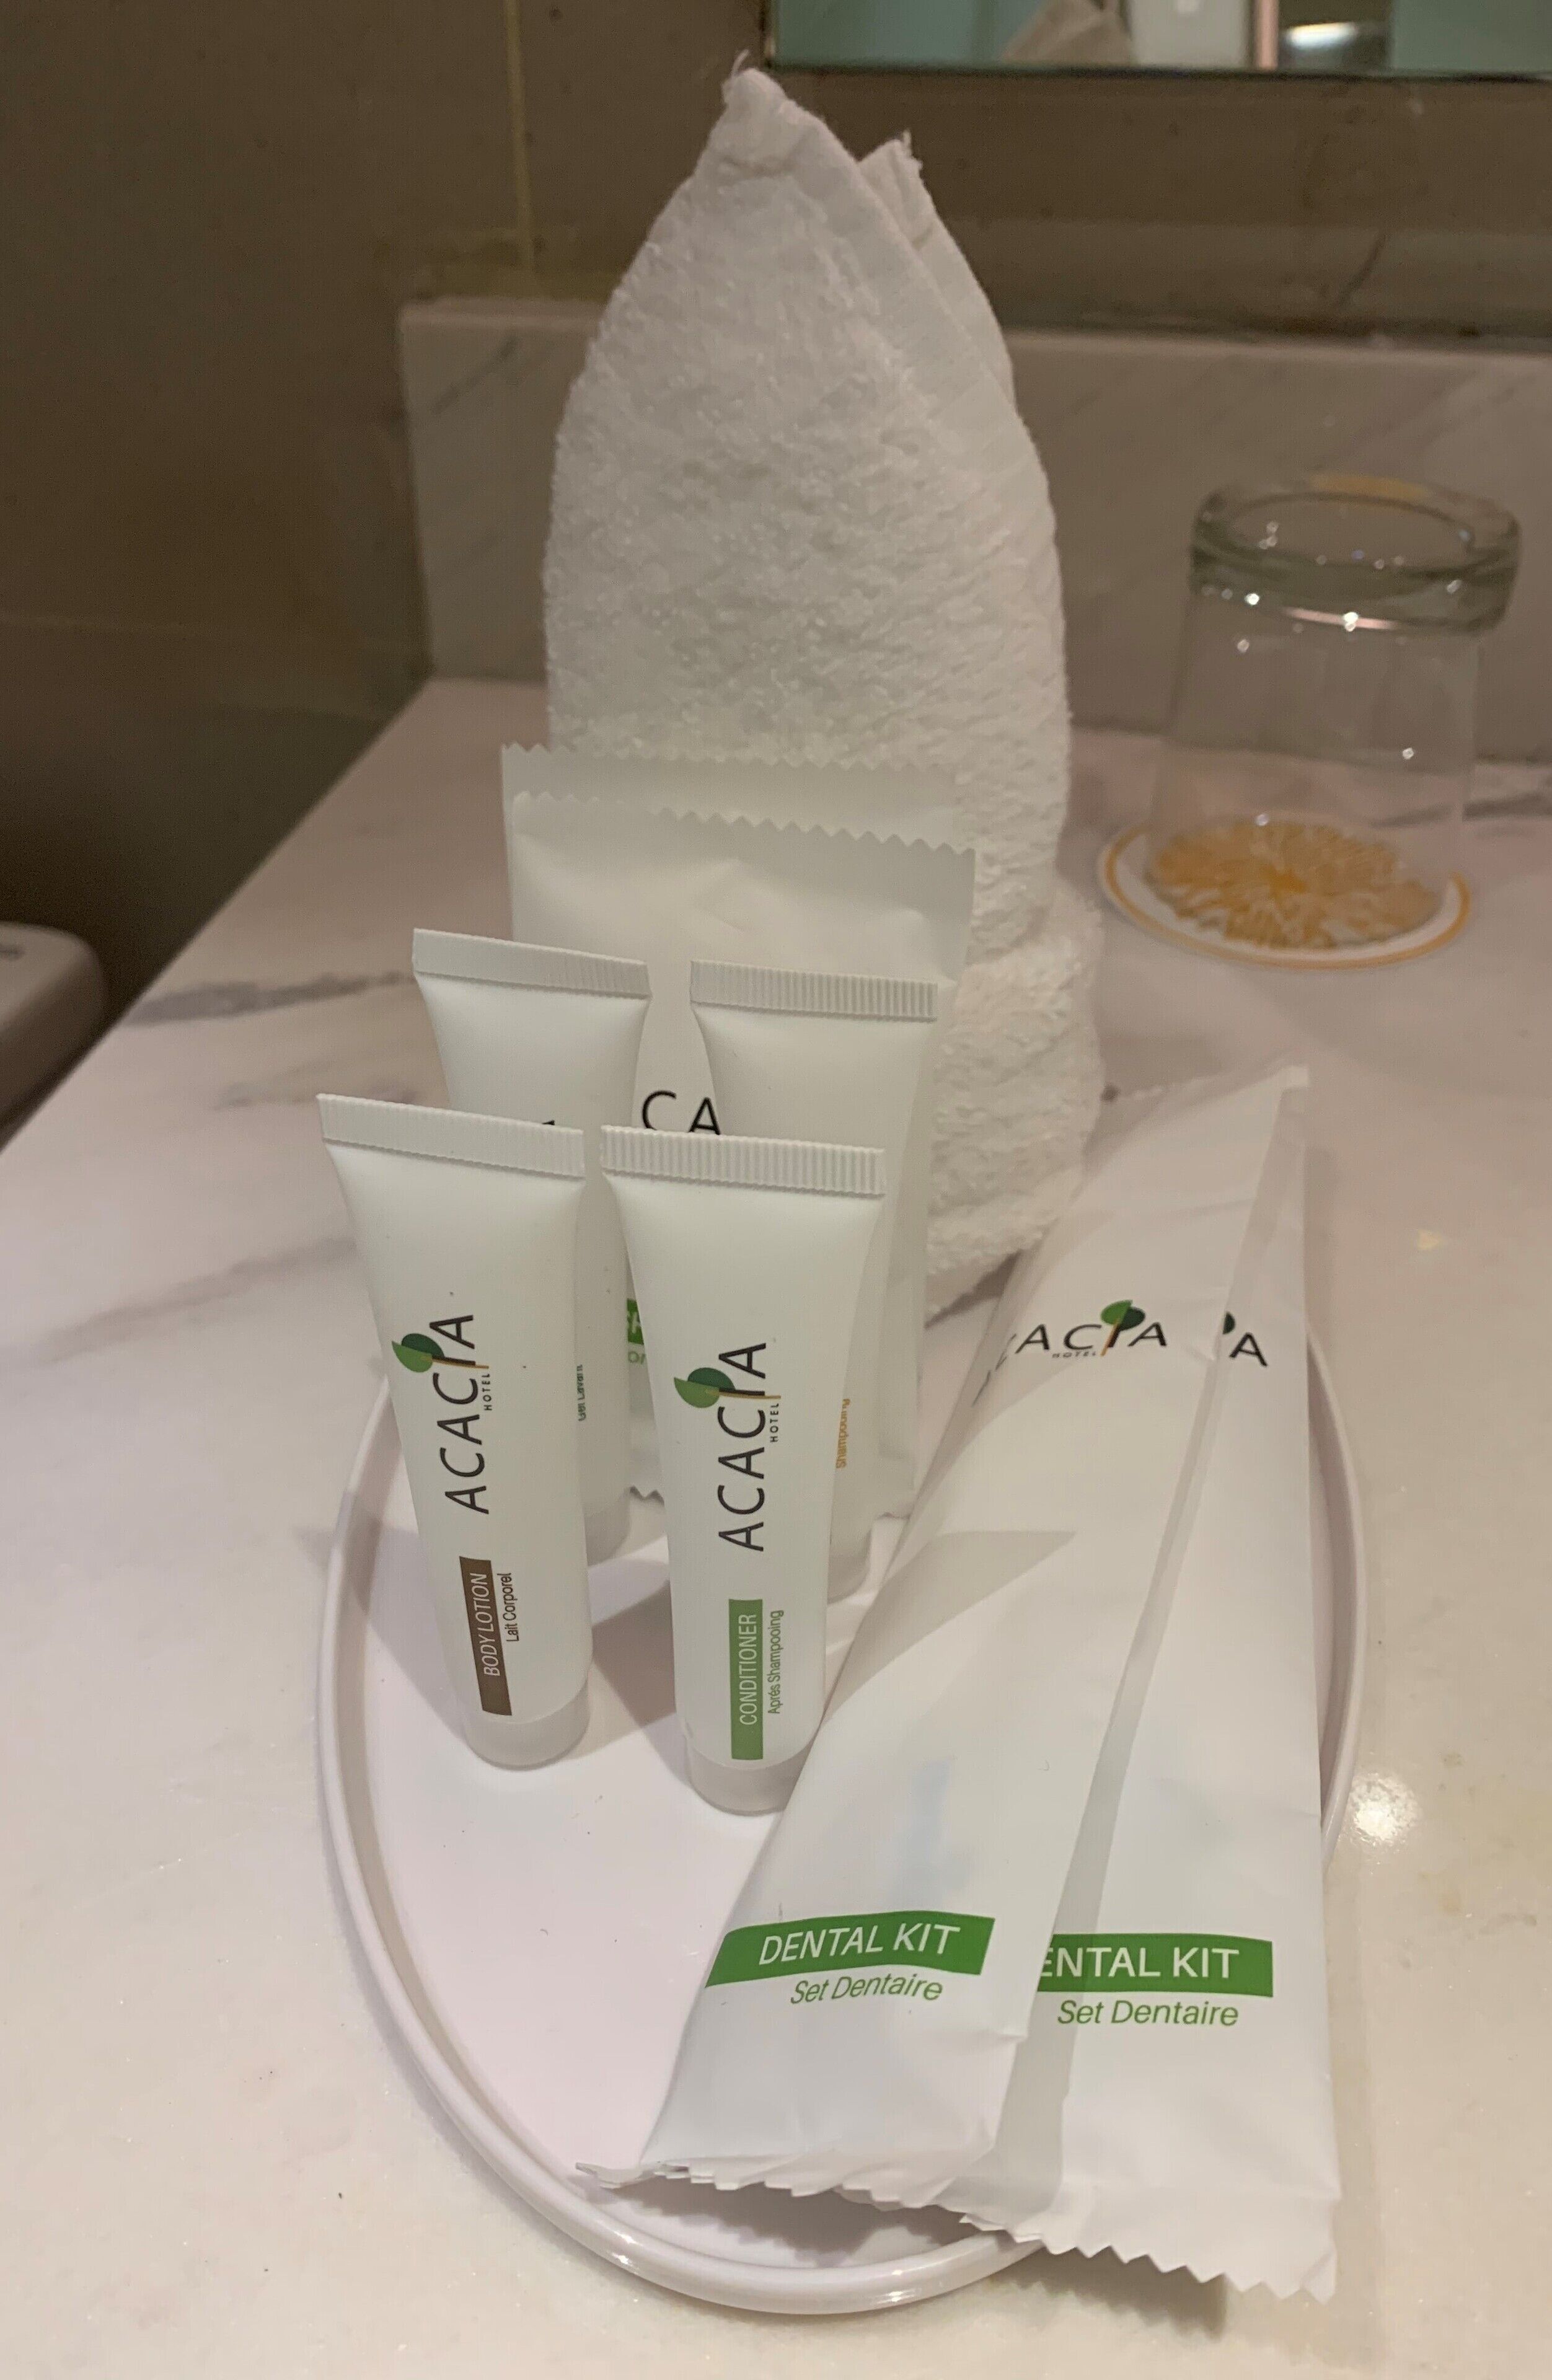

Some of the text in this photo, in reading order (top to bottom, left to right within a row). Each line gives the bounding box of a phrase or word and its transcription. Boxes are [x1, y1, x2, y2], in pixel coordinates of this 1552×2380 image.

[429, 1314, 489, 1515] ACACIA
[481, 1373, 493, 1411] HOTEL
[717, 1342, 767, 1552] ACACIA
[769, 1403, 780, 1443] HOTEL
[469, 1572, 501, 1677] BODY LOTION
[497, 1572, 520, 1642] Lait Corporel
[738, 1614, 758, 1726] CONDITIONER
[767, 1610, 785, 1683] Shampooing
[758, 1923, 961, 1966] DENTAL KIT
[1172, 1946, 1240, 1979] KIT
[790, 1973, 943, 2005] Set Dentaire
[1057, 1999, 1239, 2027] Set Dentaire
